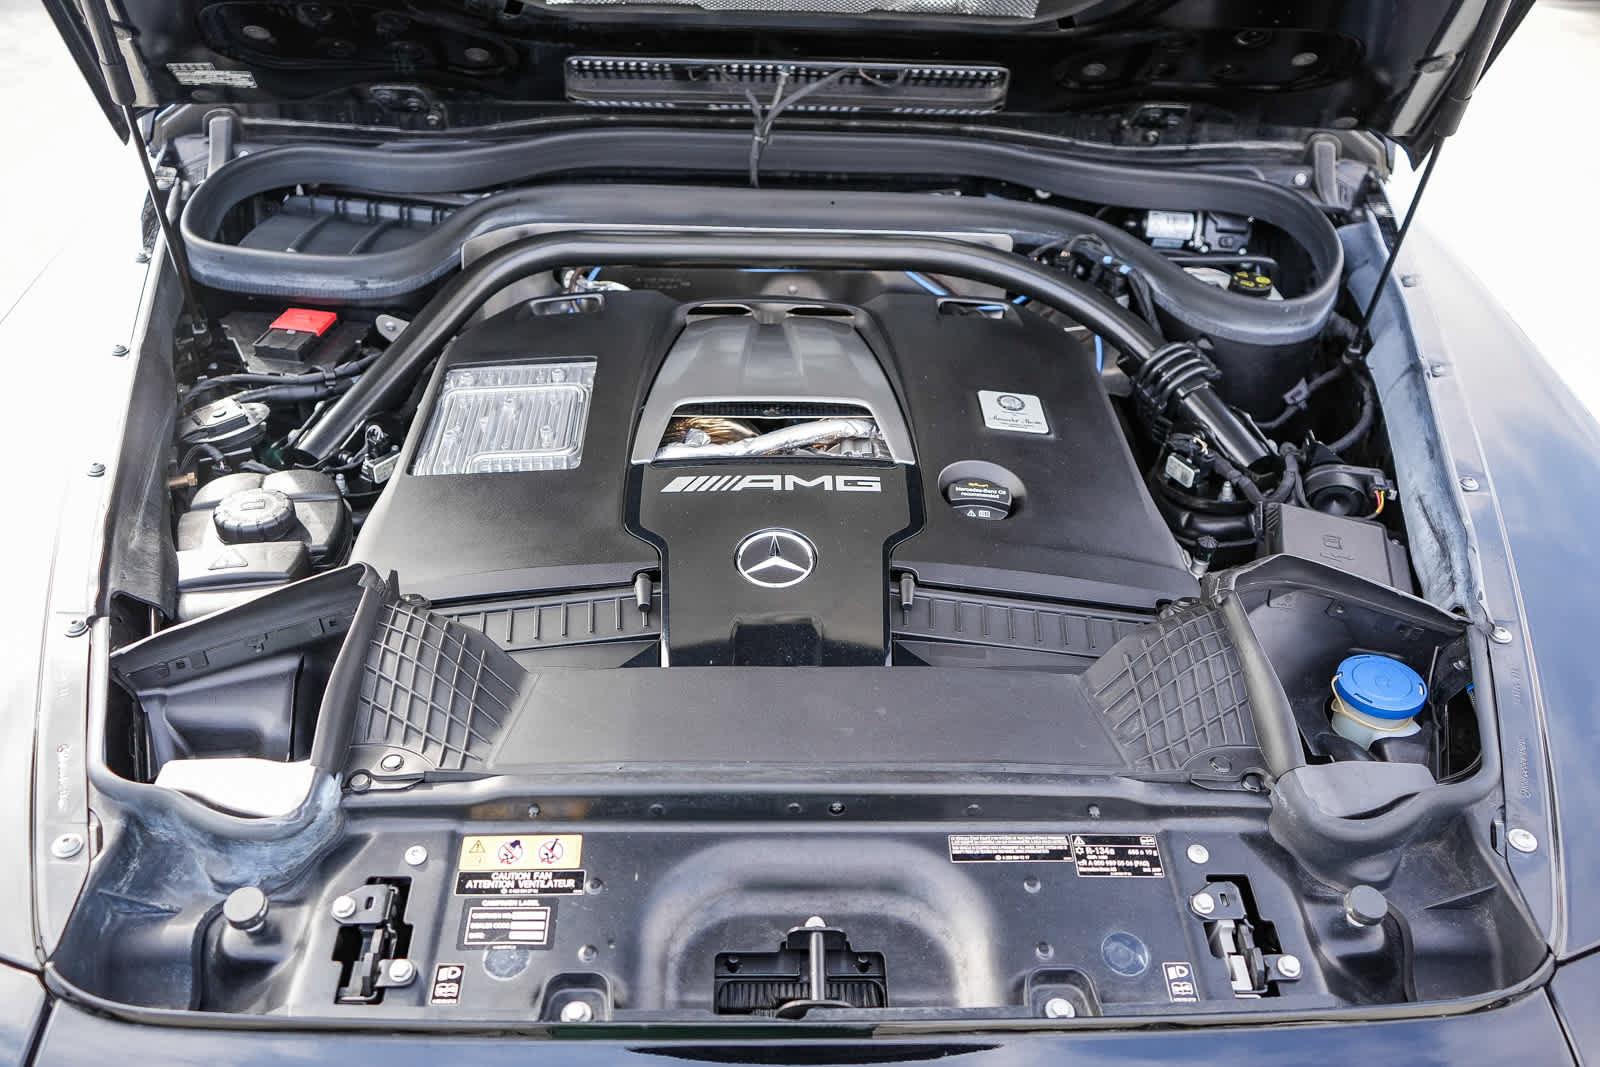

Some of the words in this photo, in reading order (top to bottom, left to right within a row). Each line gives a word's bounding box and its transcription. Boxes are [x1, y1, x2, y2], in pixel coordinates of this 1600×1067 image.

[730, 474, 882, 492] AMG
[491, 871, 533, 880] CAUTION
[534, 871, 552, 880] FAN
[465, 879, 515, 889] ATTENTION
[518, 879, 576, 888] VENTILATEUR
